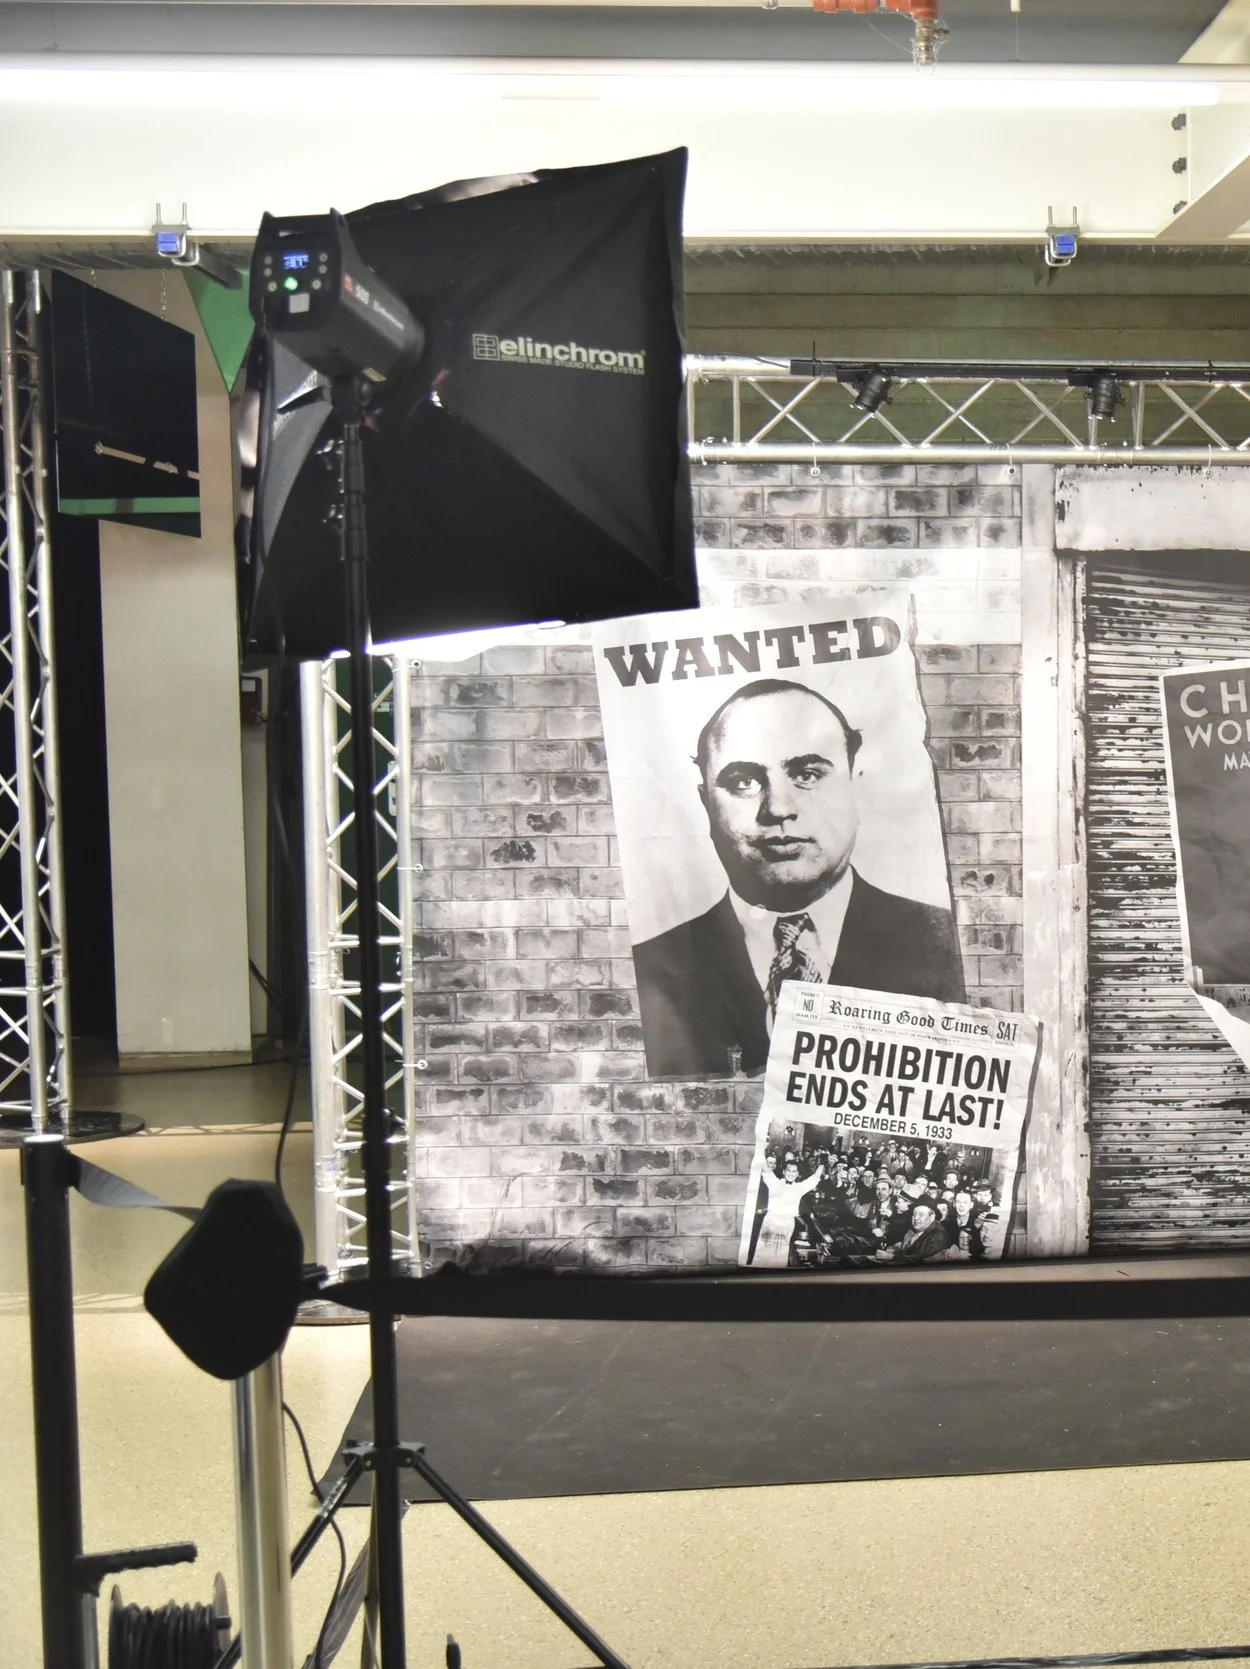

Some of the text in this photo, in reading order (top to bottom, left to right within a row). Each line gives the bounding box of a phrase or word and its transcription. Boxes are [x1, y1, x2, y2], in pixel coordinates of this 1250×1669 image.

[500, 336, 645, 369] elinchrom
[529, 357, 552, 366] MADE
[555, 360, 585, 369] STUDIO
[586, 363, 611, 372] FLASH
[613, 365, 645, 375] SYSTEM
[603, 616, 901, 687] WANTED
[803, 998, 814, 1012] NO
[828, 1000, 988, 1036] Roaring Good Times
[997, 1021, 1019, 1041] SAT
[792, 1030, 1011, 1094] PROHIBITION
[786, 1071, 1004, 1130] ENDS AT LAST!
[834, 1112, 953, 1139] DECEMBER 5, 1933
